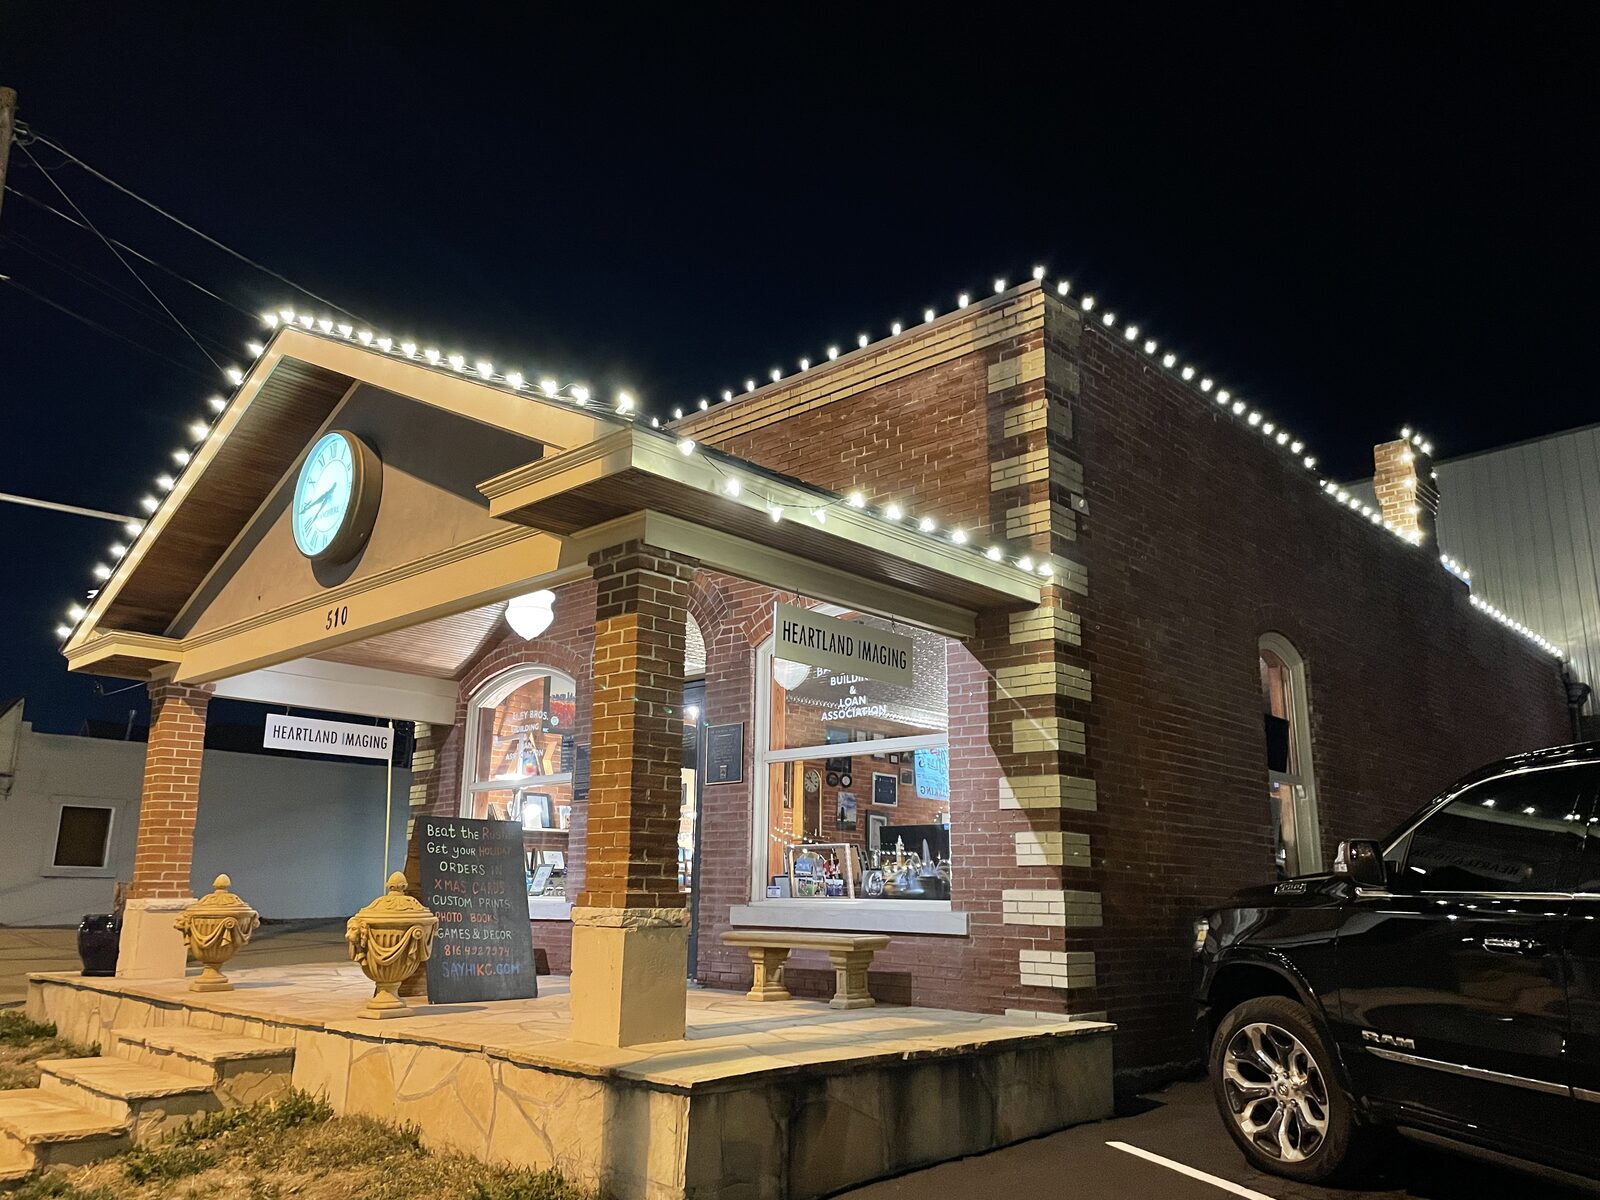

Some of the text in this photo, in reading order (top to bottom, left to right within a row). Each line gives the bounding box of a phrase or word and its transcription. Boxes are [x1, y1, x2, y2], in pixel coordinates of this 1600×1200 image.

[325, 606, 349, 631] 510
[782, 620, 908, 670] HEARTLAND IMAGING
[838, 695, 867, 707] LOAN
[821, 704, 887, 721] ASSOCIATION
[272, 724, 388, 750] HEARTLAND IMAGING
[461, 825, 479, 840] the
[427, 842, 448, 855] Get
[439, 861, 486, 876] ORDERS
[472, 882, 505, 895] CARDS
[432, 894, 511, 909] CUSTOM PRINTS
[435, 911, 498, 923] PHOTO BOOKS
[437, 927, 513, 941] GAMES & DECOR
[444, 945, 461, 957] 816
[442, 961, 521, 977] SAYHIKC.COM
[1361, 1030, 1416, 1050] RAM
